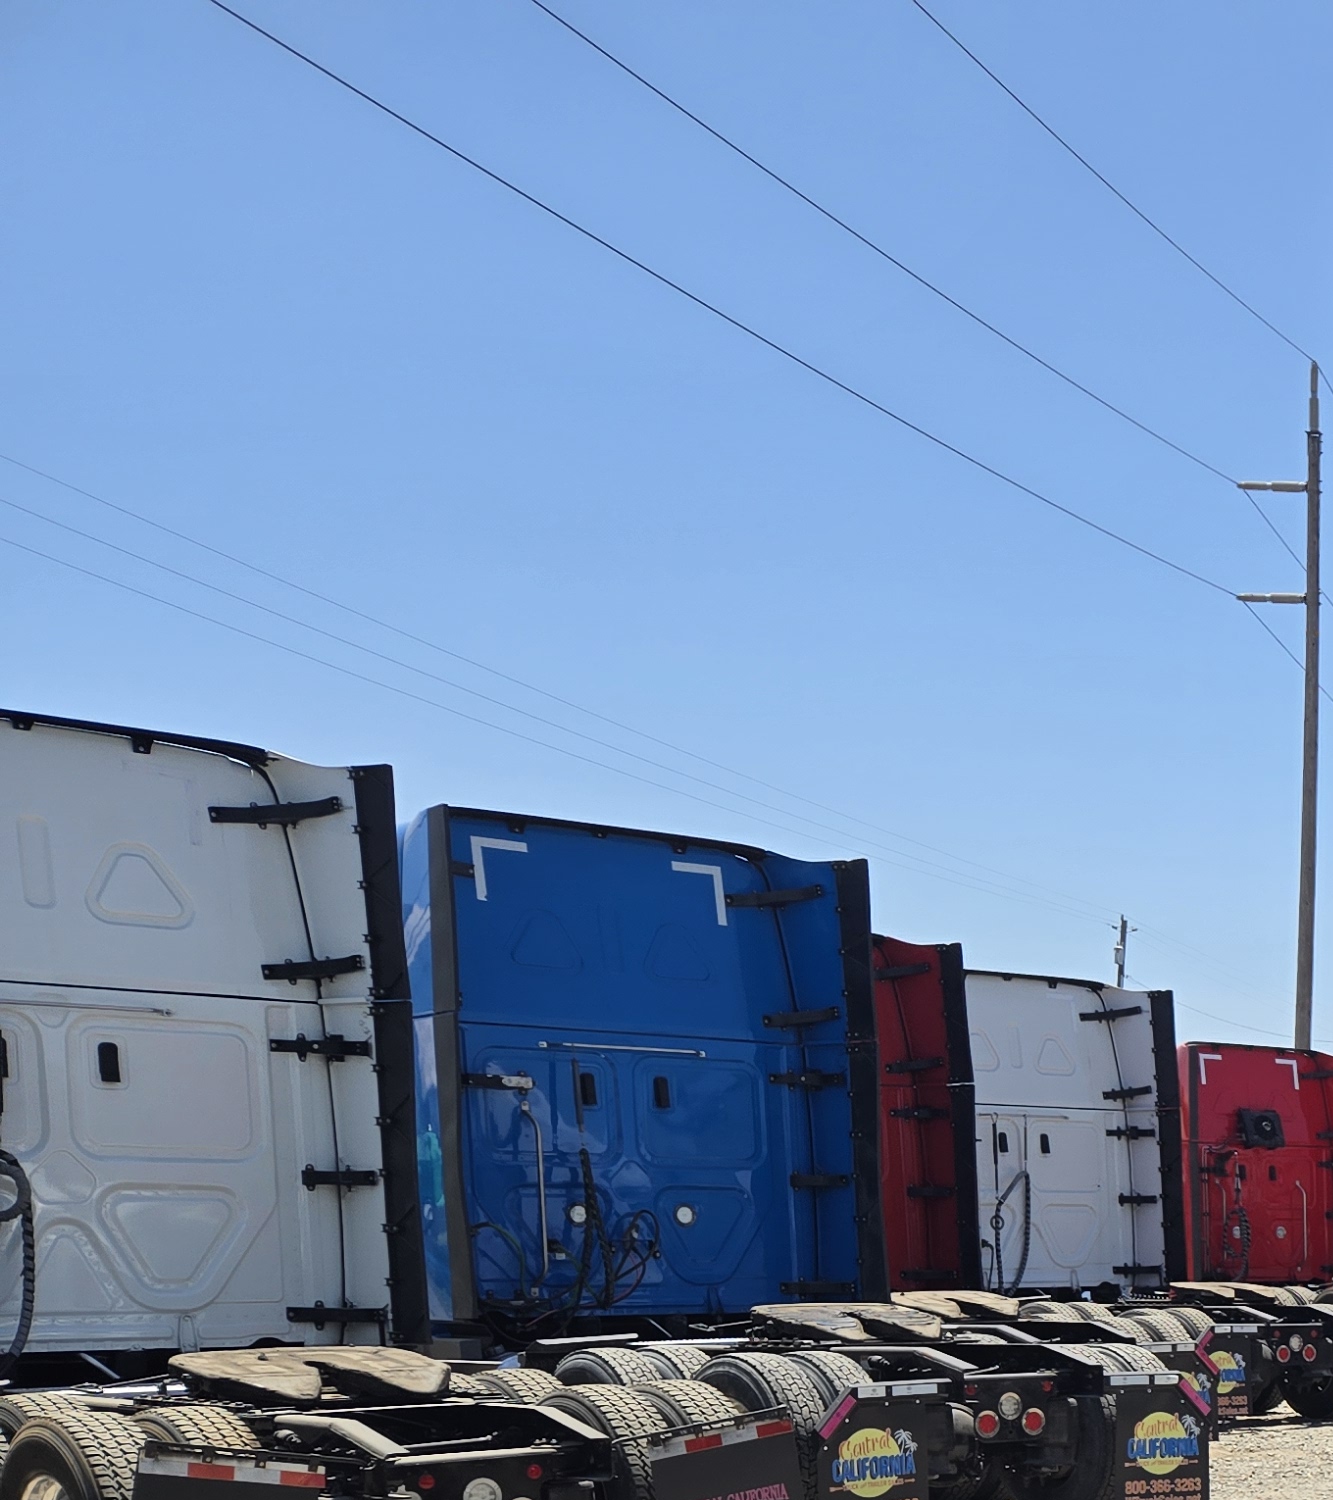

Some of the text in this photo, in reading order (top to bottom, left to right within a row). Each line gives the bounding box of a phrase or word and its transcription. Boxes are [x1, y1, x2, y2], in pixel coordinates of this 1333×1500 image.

[1134, 1412, 1180, 1439] Central
[838, 1427, 892, 1460] Central
[1127, 1437, 1199, 1459] CALIFORNIA
[832, 1454, 916, 1483] CALIFORNIA
[1125, 1477, 1201, 1494] 800-366-3263
